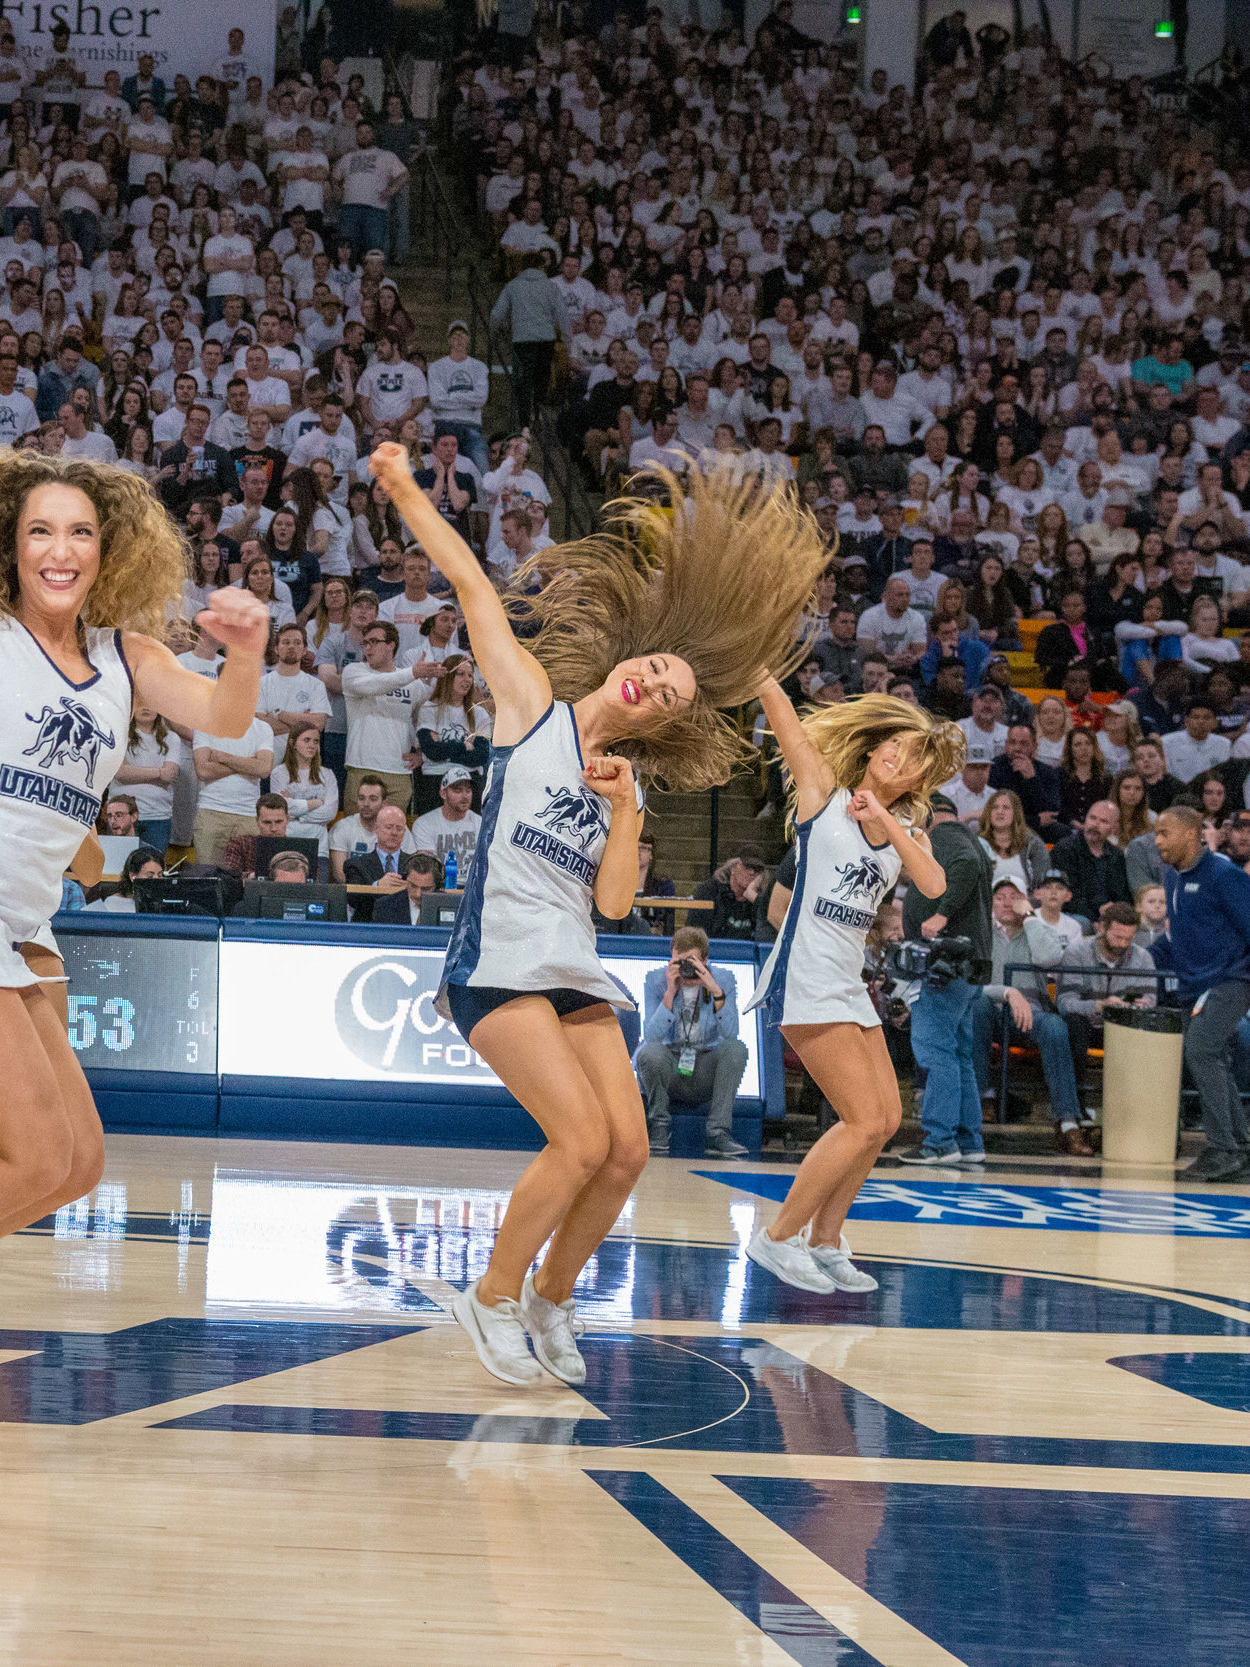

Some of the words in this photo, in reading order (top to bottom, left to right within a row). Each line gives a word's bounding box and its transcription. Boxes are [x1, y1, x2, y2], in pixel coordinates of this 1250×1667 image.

[58, 783, 101, 829] STATE
[510, 821, 561, 862] UTAH
[557, 841, 597, 885] STATE
[814, 897, 854, 927] UTAH
[852, 908, 876, 931] STA
[190, 968, 199, 981] F
[67, 995, 135, 1051] 53
